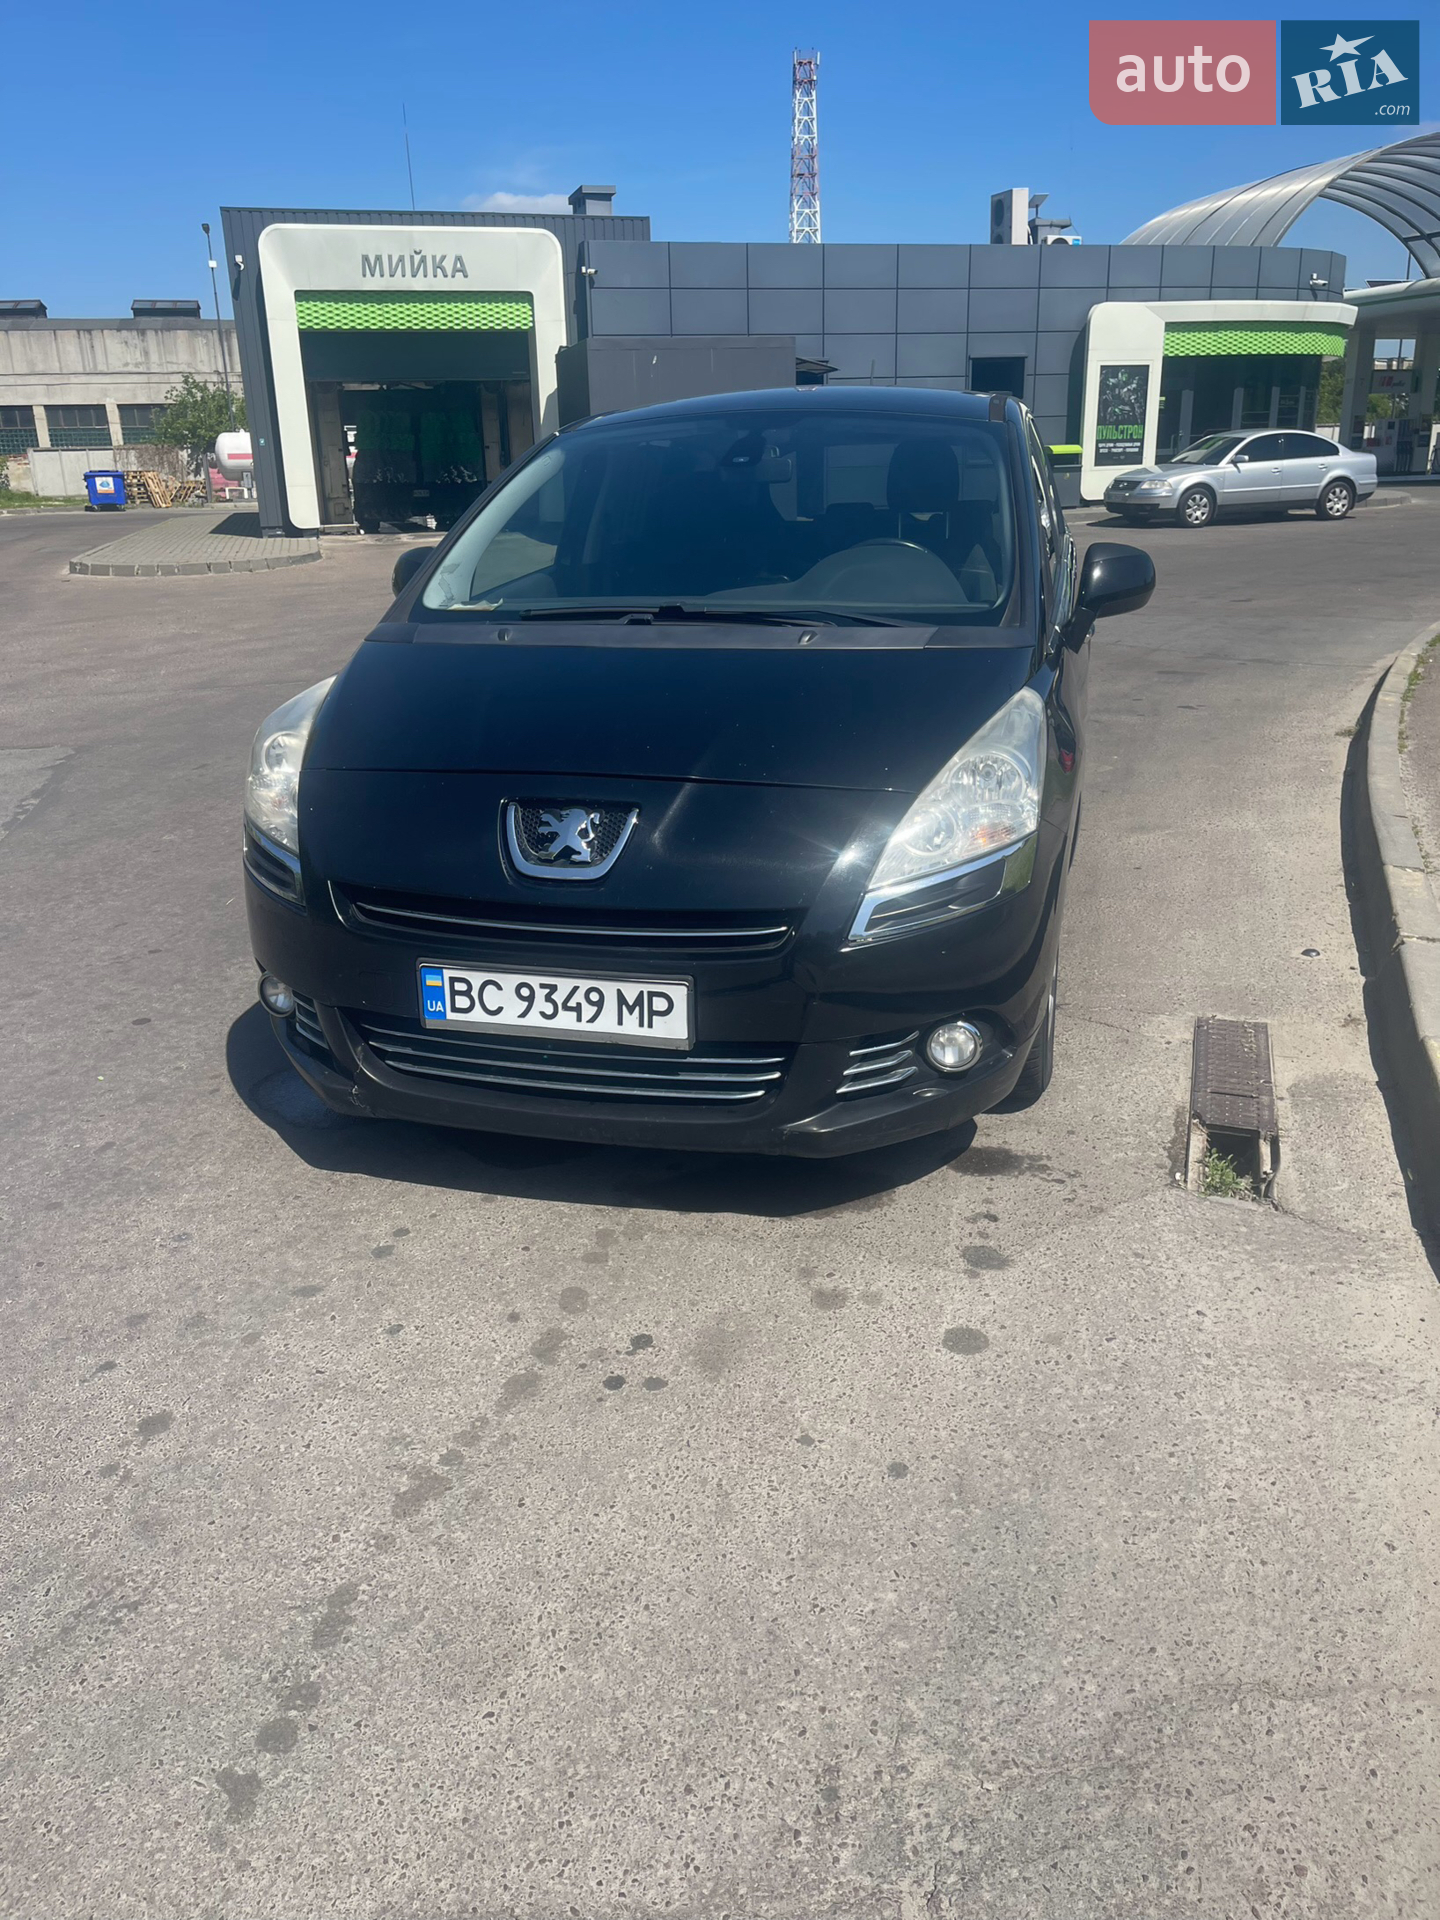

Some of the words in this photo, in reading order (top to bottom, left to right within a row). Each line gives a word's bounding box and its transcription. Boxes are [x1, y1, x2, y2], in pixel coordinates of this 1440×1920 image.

[361, 249, 469, 278] МИЙКА
[1097, 425, 1143, 439] ПУЛЬСТРОН
[427, 1000, 445, 1013] UA
[448, 976, 504, 1016] BC
[514, 982, 605, 1024] 9349
[616, 987, 675, 1029] MP
